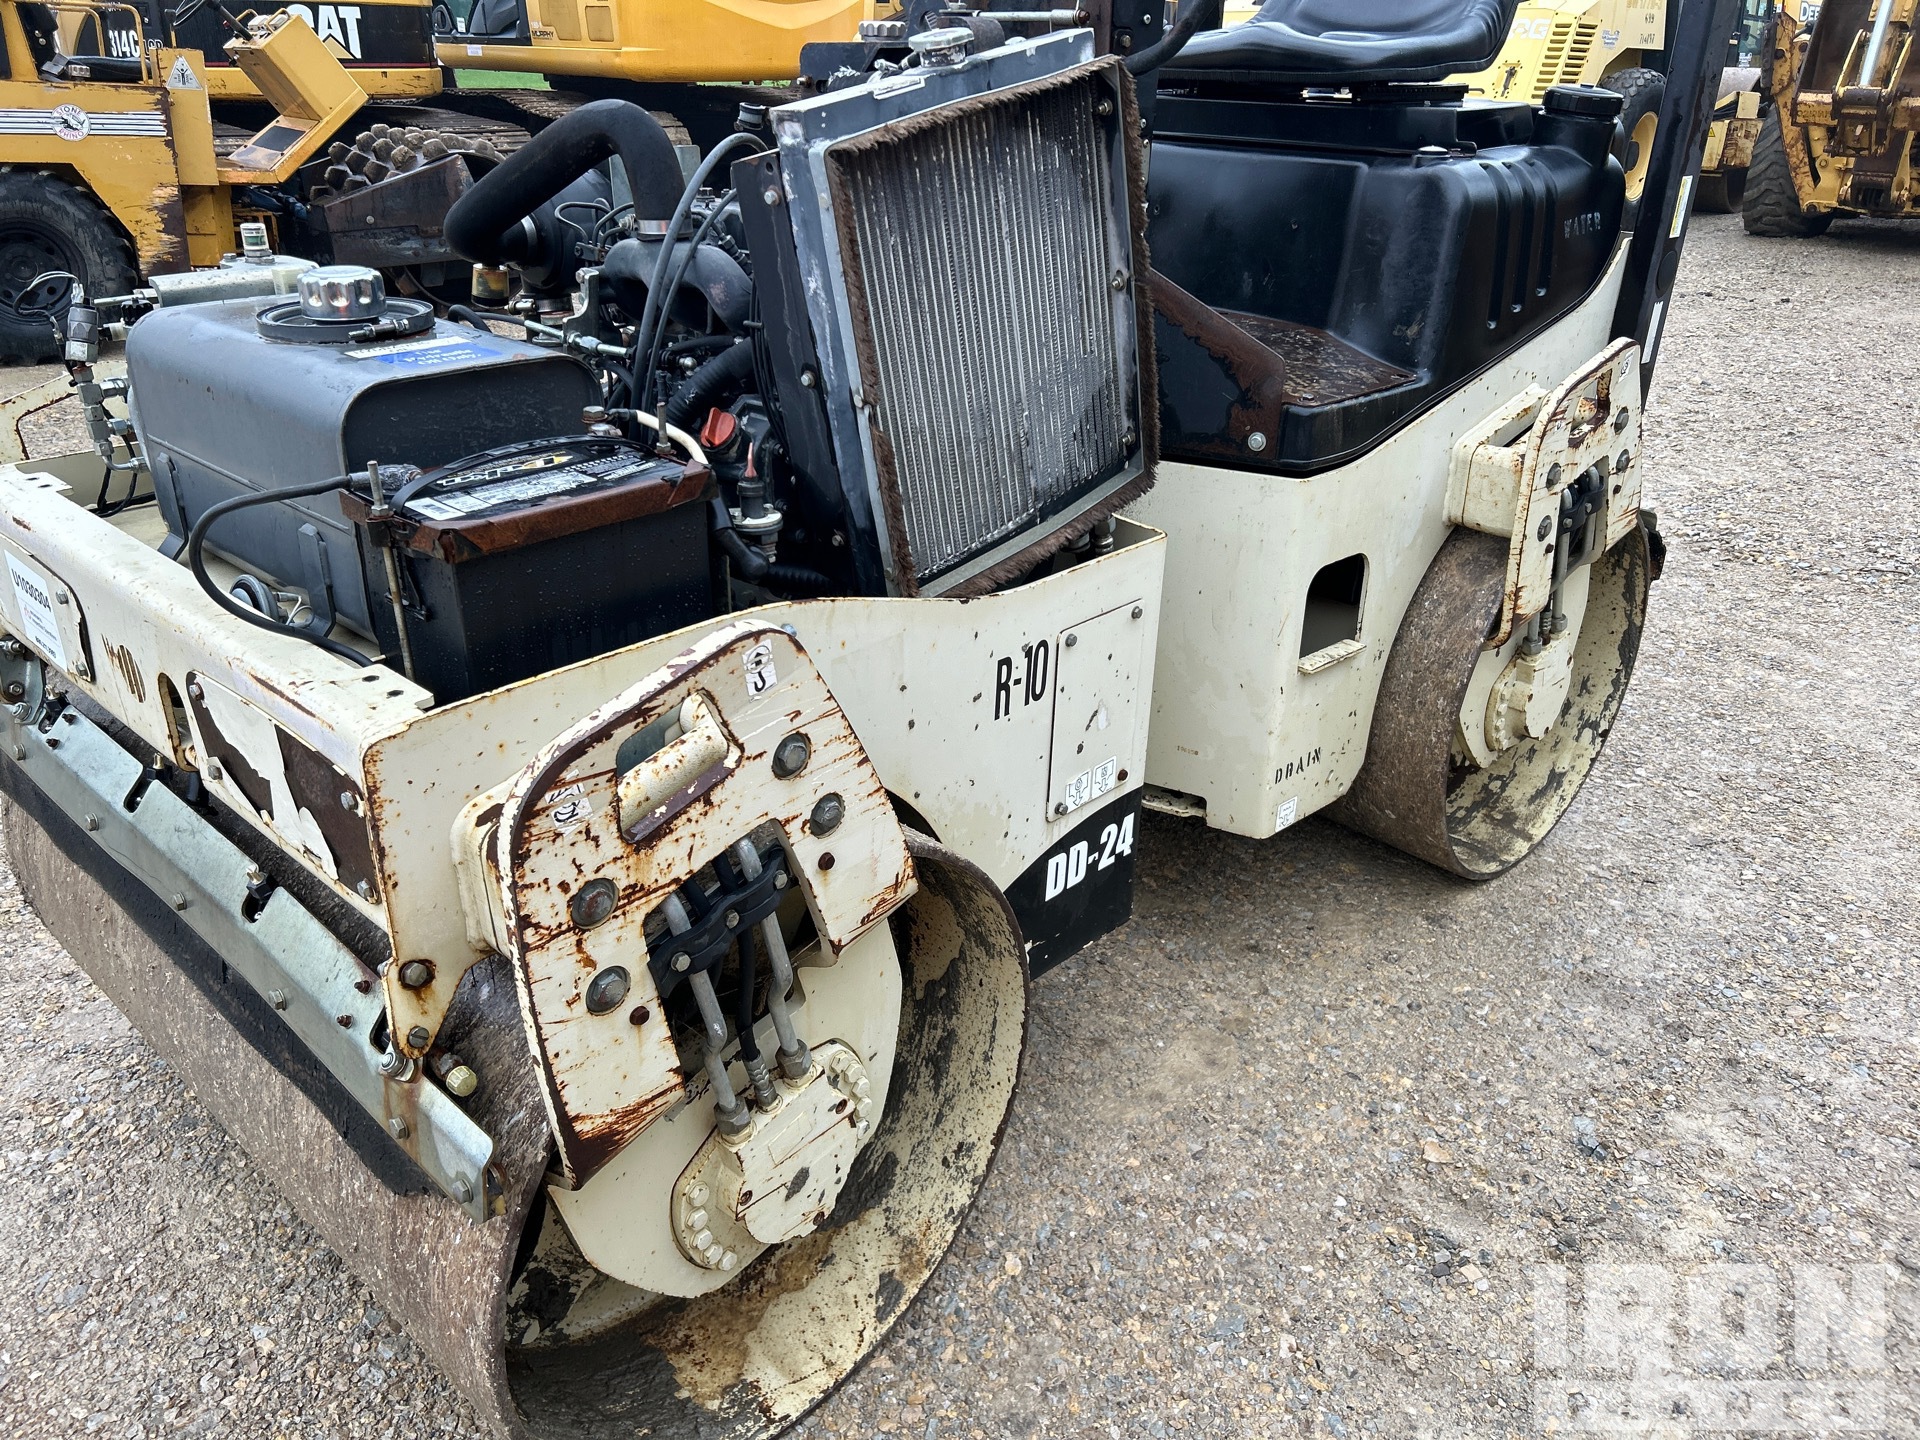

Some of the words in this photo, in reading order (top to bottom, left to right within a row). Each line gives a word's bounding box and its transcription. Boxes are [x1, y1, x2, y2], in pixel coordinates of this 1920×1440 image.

[1799, 1, 1821, 22] DEE
[108, 30, 140, 57] 314C
[55, 105, 82, 116] STONE
[59, 127, 84, 139] RHINO
[1563, 211, 1601, 239] WATER
[994, 639, 1049, 721] R-10
[1275, 746, 1321, 785] DRAIN
[1045, 812, 1134, 902] DD-24
